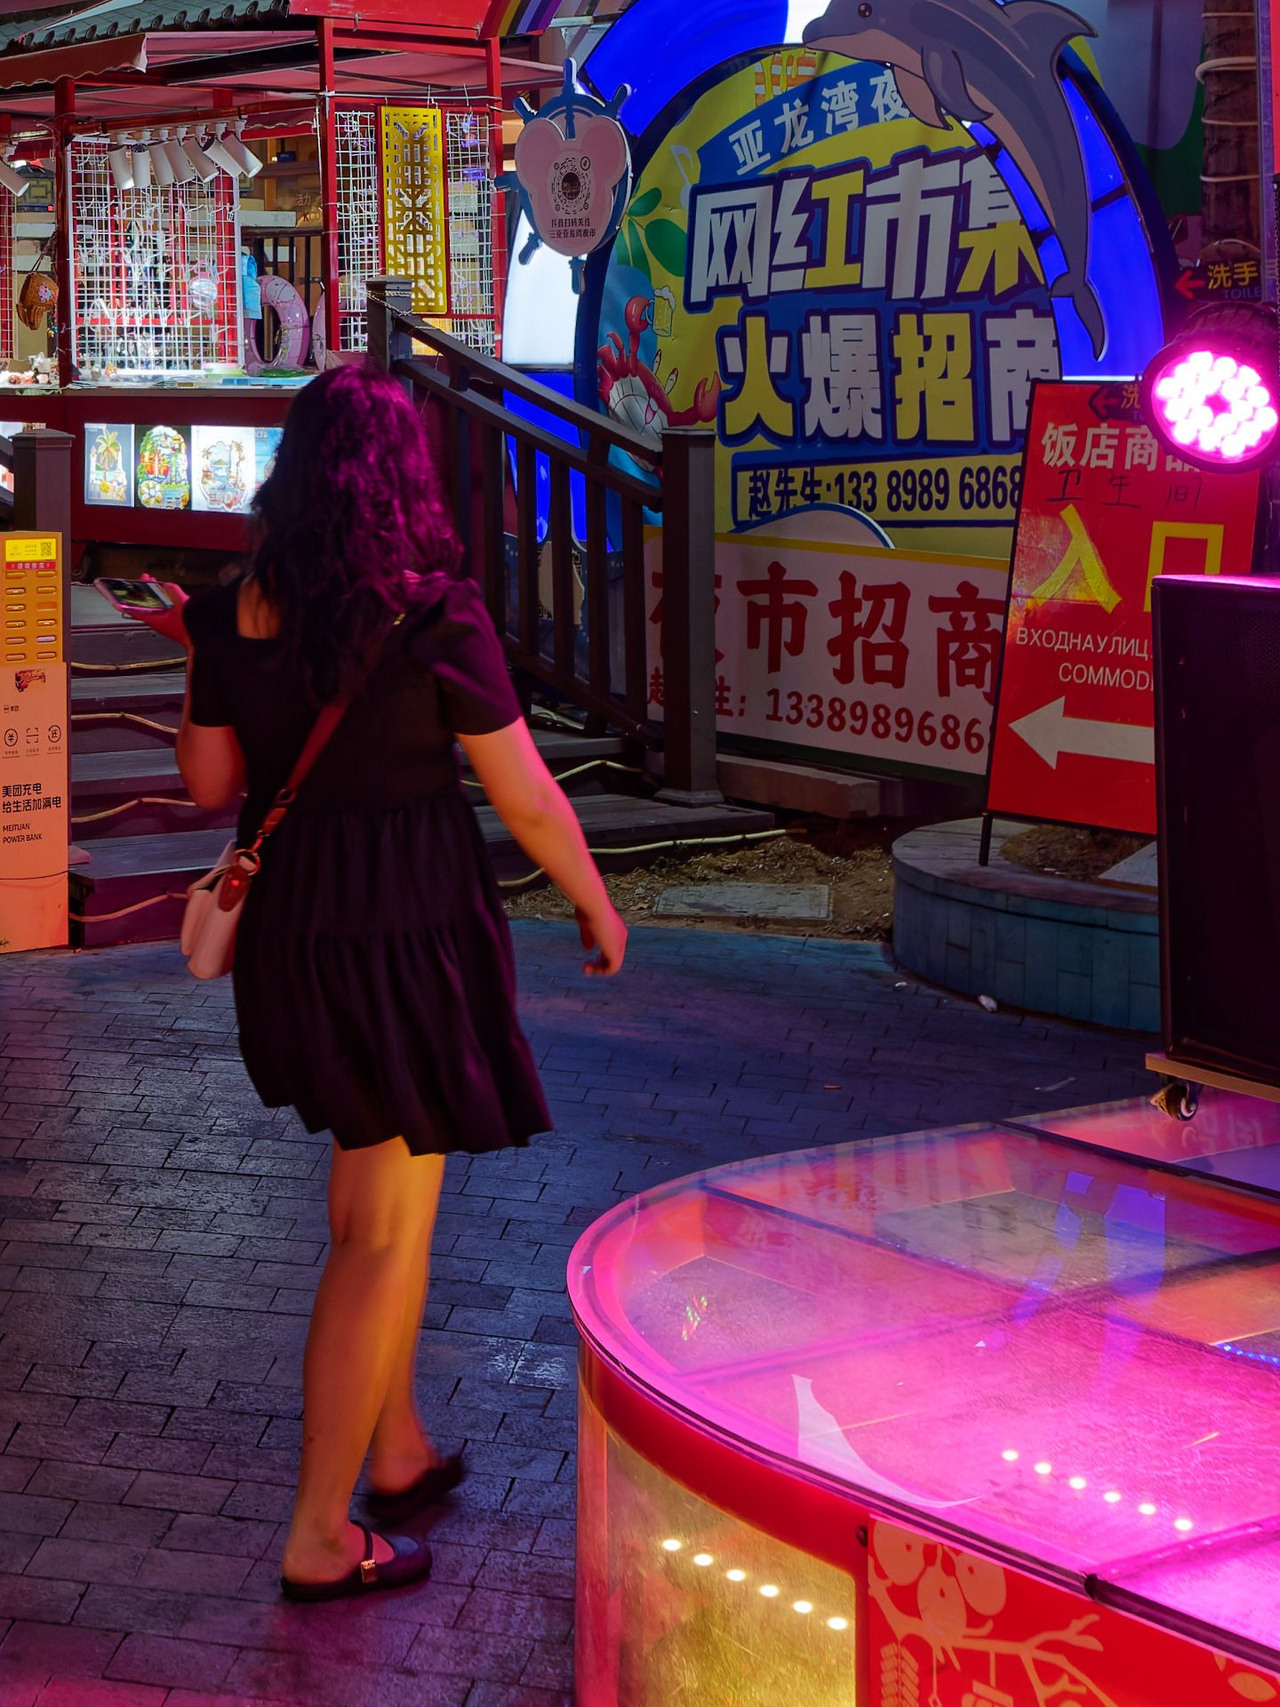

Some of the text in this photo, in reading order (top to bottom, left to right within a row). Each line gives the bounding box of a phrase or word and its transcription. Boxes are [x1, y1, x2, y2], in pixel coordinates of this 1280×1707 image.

[691, 154, 1046, 304] 网红市集
[722, 310, 1061, 444] 火爆招商
[886, 465, 950, 513] 8989
[1031, 502, 1225, 615] 入口
[1016, 626, 1153, 661] ВХОДНАУЛИЦ
[765, 687, 992, 756] 1338989686
[2, 782, 42, 798] 美团充电
[2, 796, 62, 814] 给生活加满电
[2, 823, 31, 833] MEITUAN
[2, 832, 43, 845] POWER BANK
